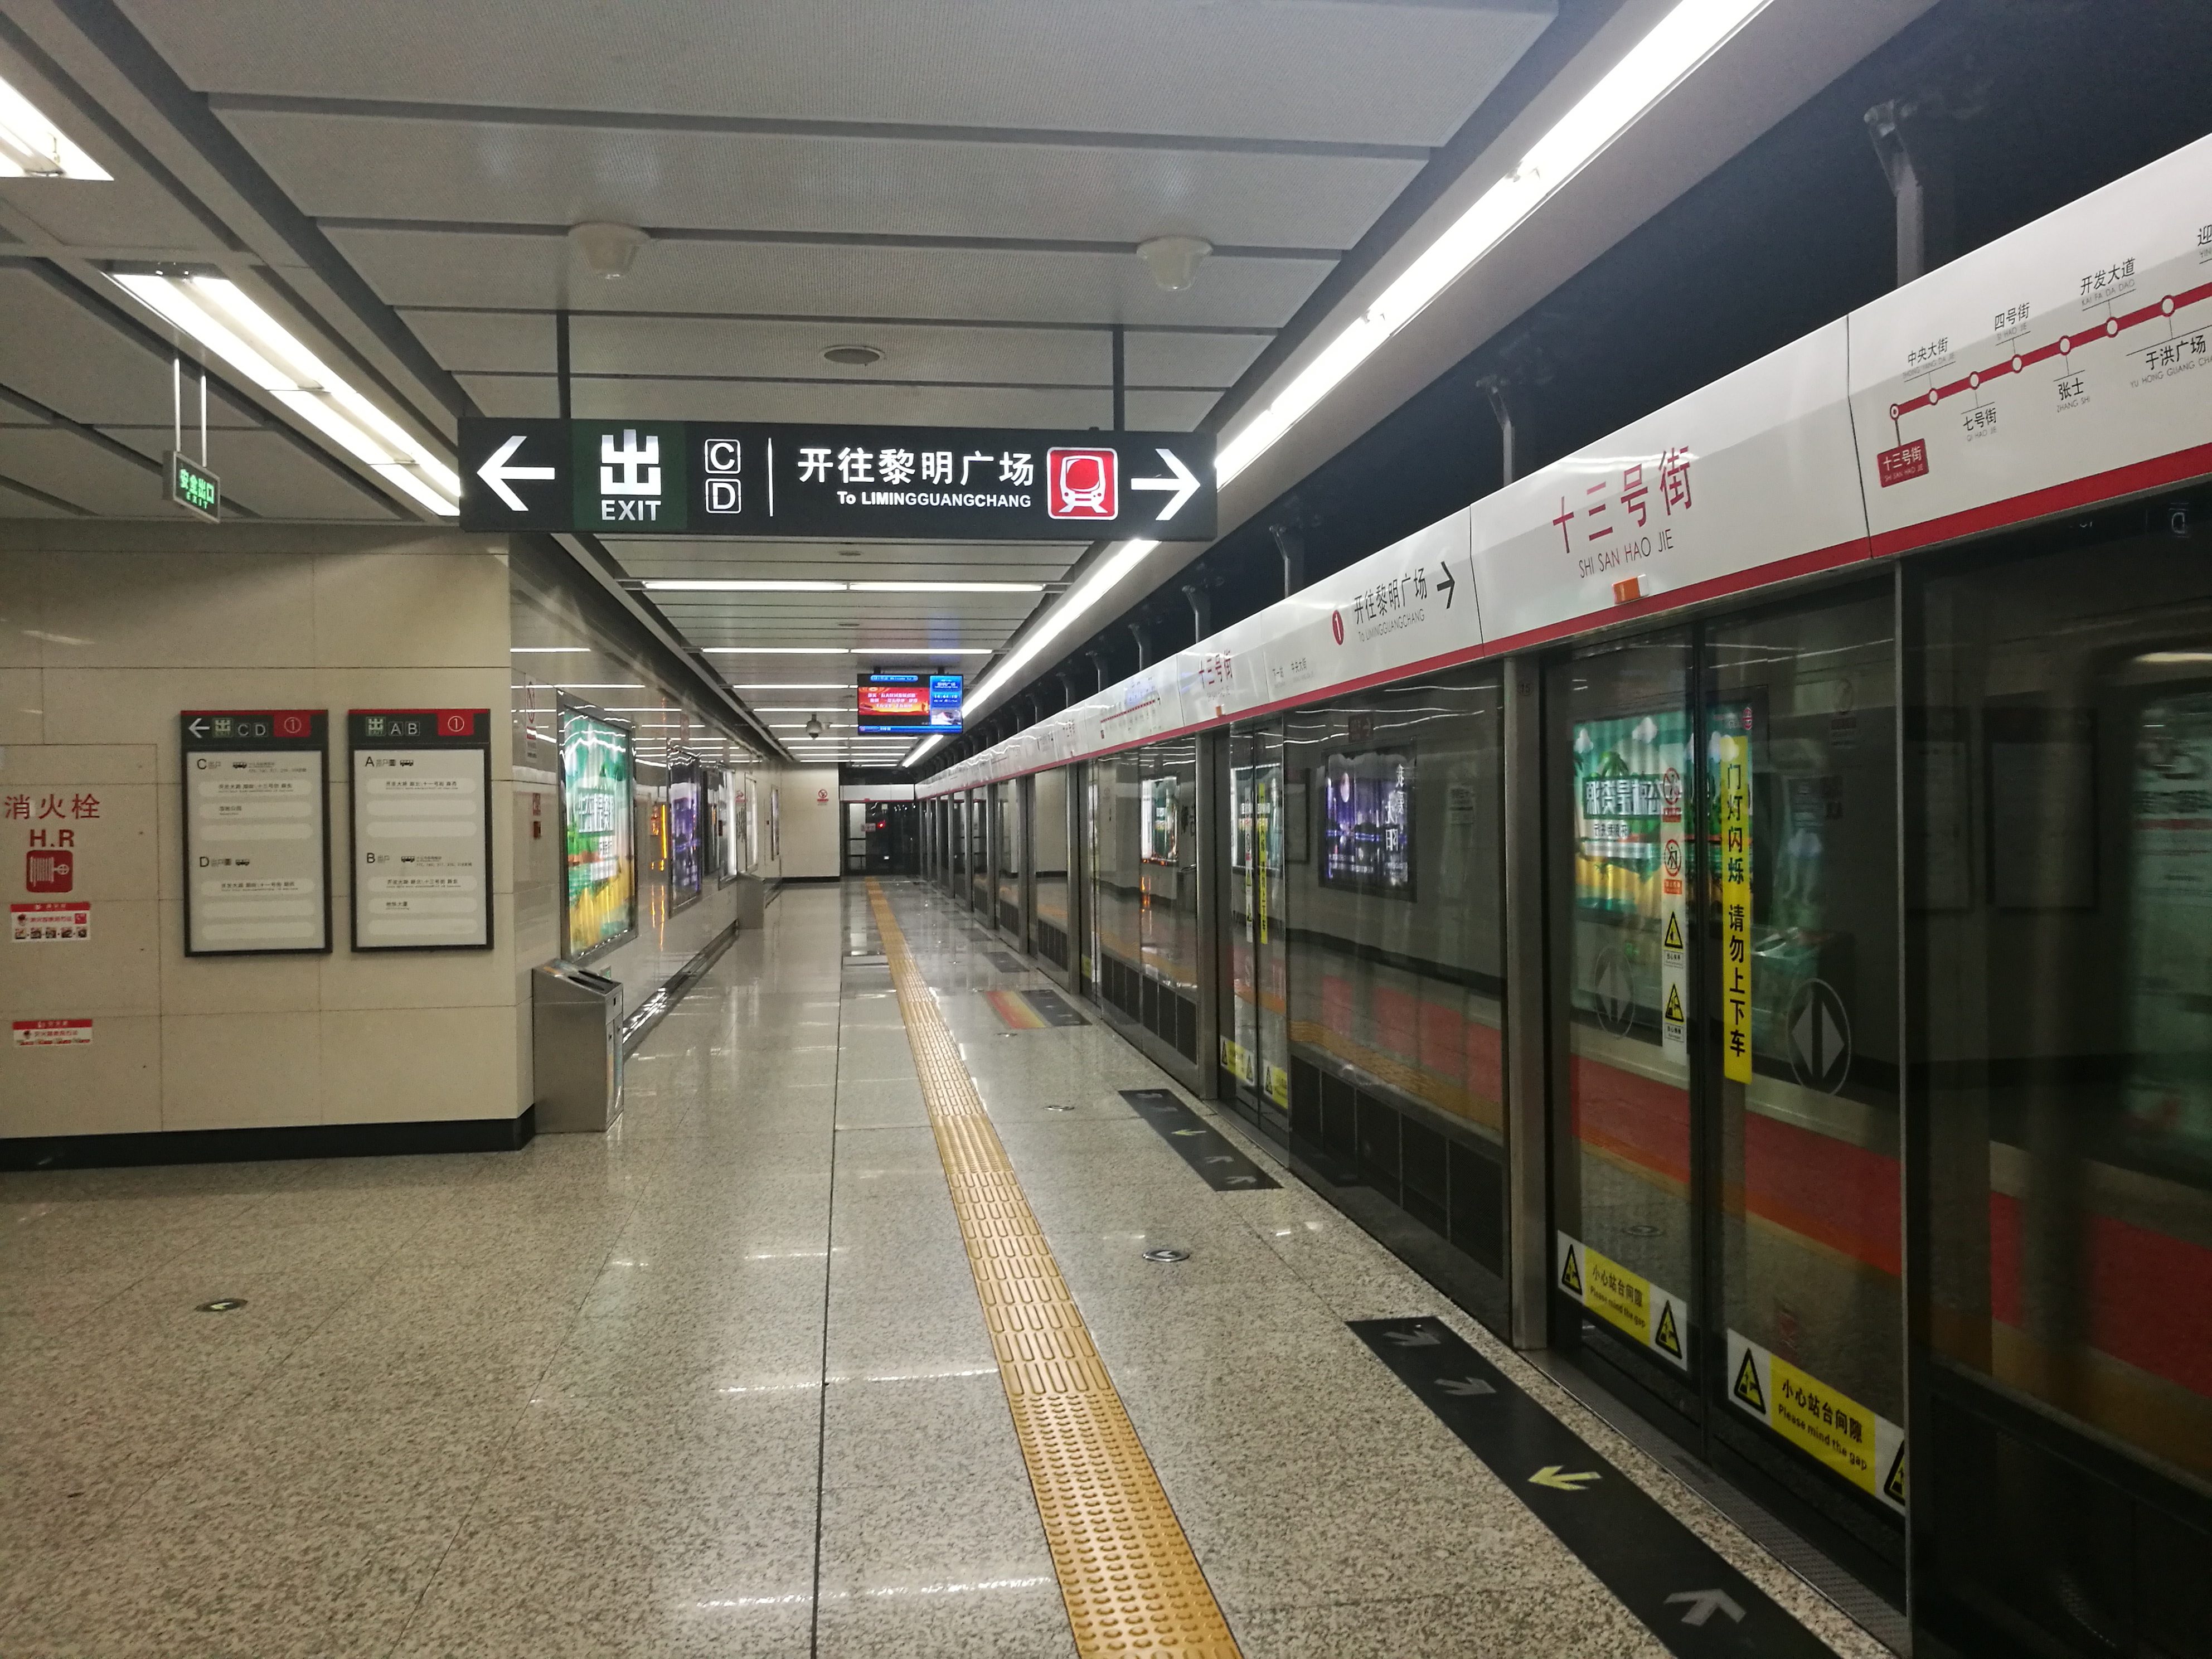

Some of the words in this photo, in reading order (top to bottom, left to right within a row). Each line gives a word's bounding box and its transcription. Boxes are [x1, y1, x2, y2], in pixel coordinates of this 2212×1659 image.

[2080, 257, 2135, 296] 开发大道
[2082, 297, 2092, 306] KAI
[2094, 292, 2103, 302] FA
[2106, 287, 2116, 297] DA
[2118, 279, 2135, 293] DAO
[1994, 302, 2030, 331] 四号街
[2004, 327, 2017, 338] HAO
[1908, 337, 1948, 367] 中央大街
[1938, 357, 1947, 365] DA
[2146, 334, 2206, 371] 于洪广场
[2131, 380, 2139, 389] YU
[2142, 371, 2164, 384] HONG
[2167, 361, 2195, 377] GUANG
[2058, 377, 2084, 401] 张士
[2056, 400, 2078, 413] ZHANG
[2081, 395, 2091, 405] SHI
[1963, 408, 1997, 432] 七号街
[1967, 434, 1973, 442] QI
[1975, 429, 1987, 439] HAO
[600, 429, 661, 495] 出
[710, 442, 735, 470] C
[797, 447, 1034, 486] 开往黎明广场
[1883, 445, 1922, 472] 十三号街
[186, 491, 208, 510] EXIT
[712, 482, 736, 510] D
[837, 491, 856, 505] To
[861, 491, 1031, 508] LIMINGGUANGCHANG
[1552, 445, 1692, 554] 十三号街
[601, 499, 662, 521] EXIT
[1579, 556, 1595, 578] SHI
[1598, 547, 1621, 573] SAN
[1624, 536, 1651, 563] HAO
[1658, 528, 1674, 552] JIE
[1354, 567, 1428, 625] 开往黎明广场
[1358, 630, 1365, 642] To
[1366, 608, 1425, 641] LIMINGGUANGCHANG
[237, 724, 249, 736] C
[255, 724, 266, 736] D
[391, 723, 401, 735] A
[408, 723, 418, 735] B
[197, 758, 207, 770] C
[365, 756, 375, 767] A
[4, 793, 100, 820] 消火栓
[1726, 763, 1745, 885] 门灯闪烁
[29, 829, 75, 847] H.R
[200, 856, 210, 867] D
[367, 852, 375, 864] B
[1728, 904, 1746, 1058] 请勿上下车
[1592, 1264, 1642, 1308] 小心站台间隙
[1590, 1286, 1608, 1302] Please
[1608, 1299, 1623, 1314] mind
[1623, 1307, 1633, 1320] the
[1634, 1316, 1646, 1328] gap
[1782, 1379, 1863, 1444] 小心站台间隙
[1778, 1403, 1806, 1430] Please
[1807, 1424, 1831, 1446] mind
[1832, 1438, 1847, 1457] the
[1849, 1452, 1867, 1472] gap
